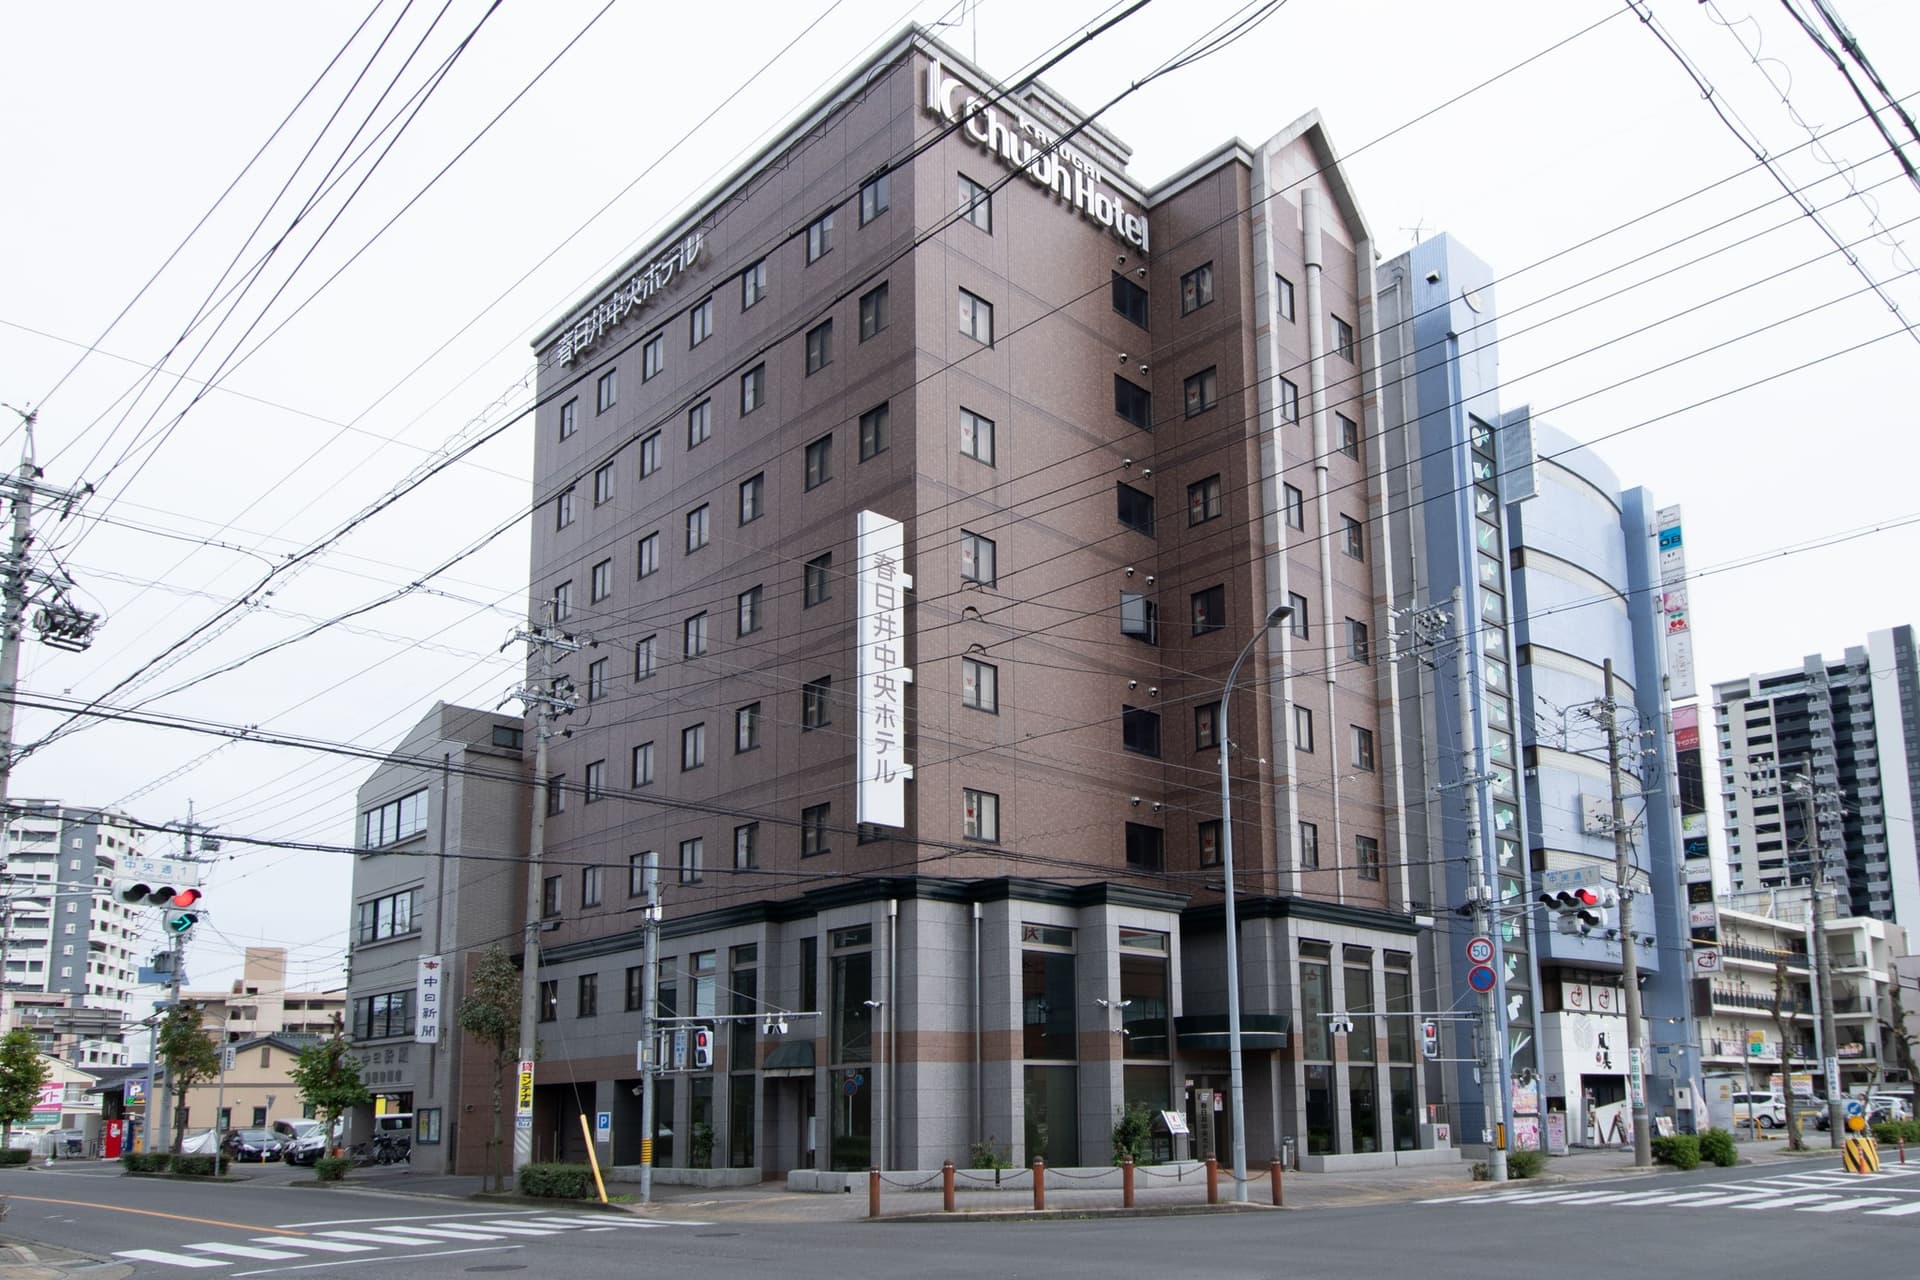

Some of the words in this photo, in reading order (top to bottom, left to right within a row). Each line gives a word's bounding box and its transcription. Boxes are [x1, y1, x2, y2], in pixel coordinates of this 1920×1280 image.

[965, 96, 1072, 201] Chuoh
[1074, 170, 1149, 252] Hotel
[557, 233, 703, 368] 春日井中央ホテル
[873, 552, 897, 785] 春日井中央ホテル
[1473, 944, 1489, 957] 50
[421, 975, 439, 1037] 中日新聞
[600, 1116, 608, 1128] P
